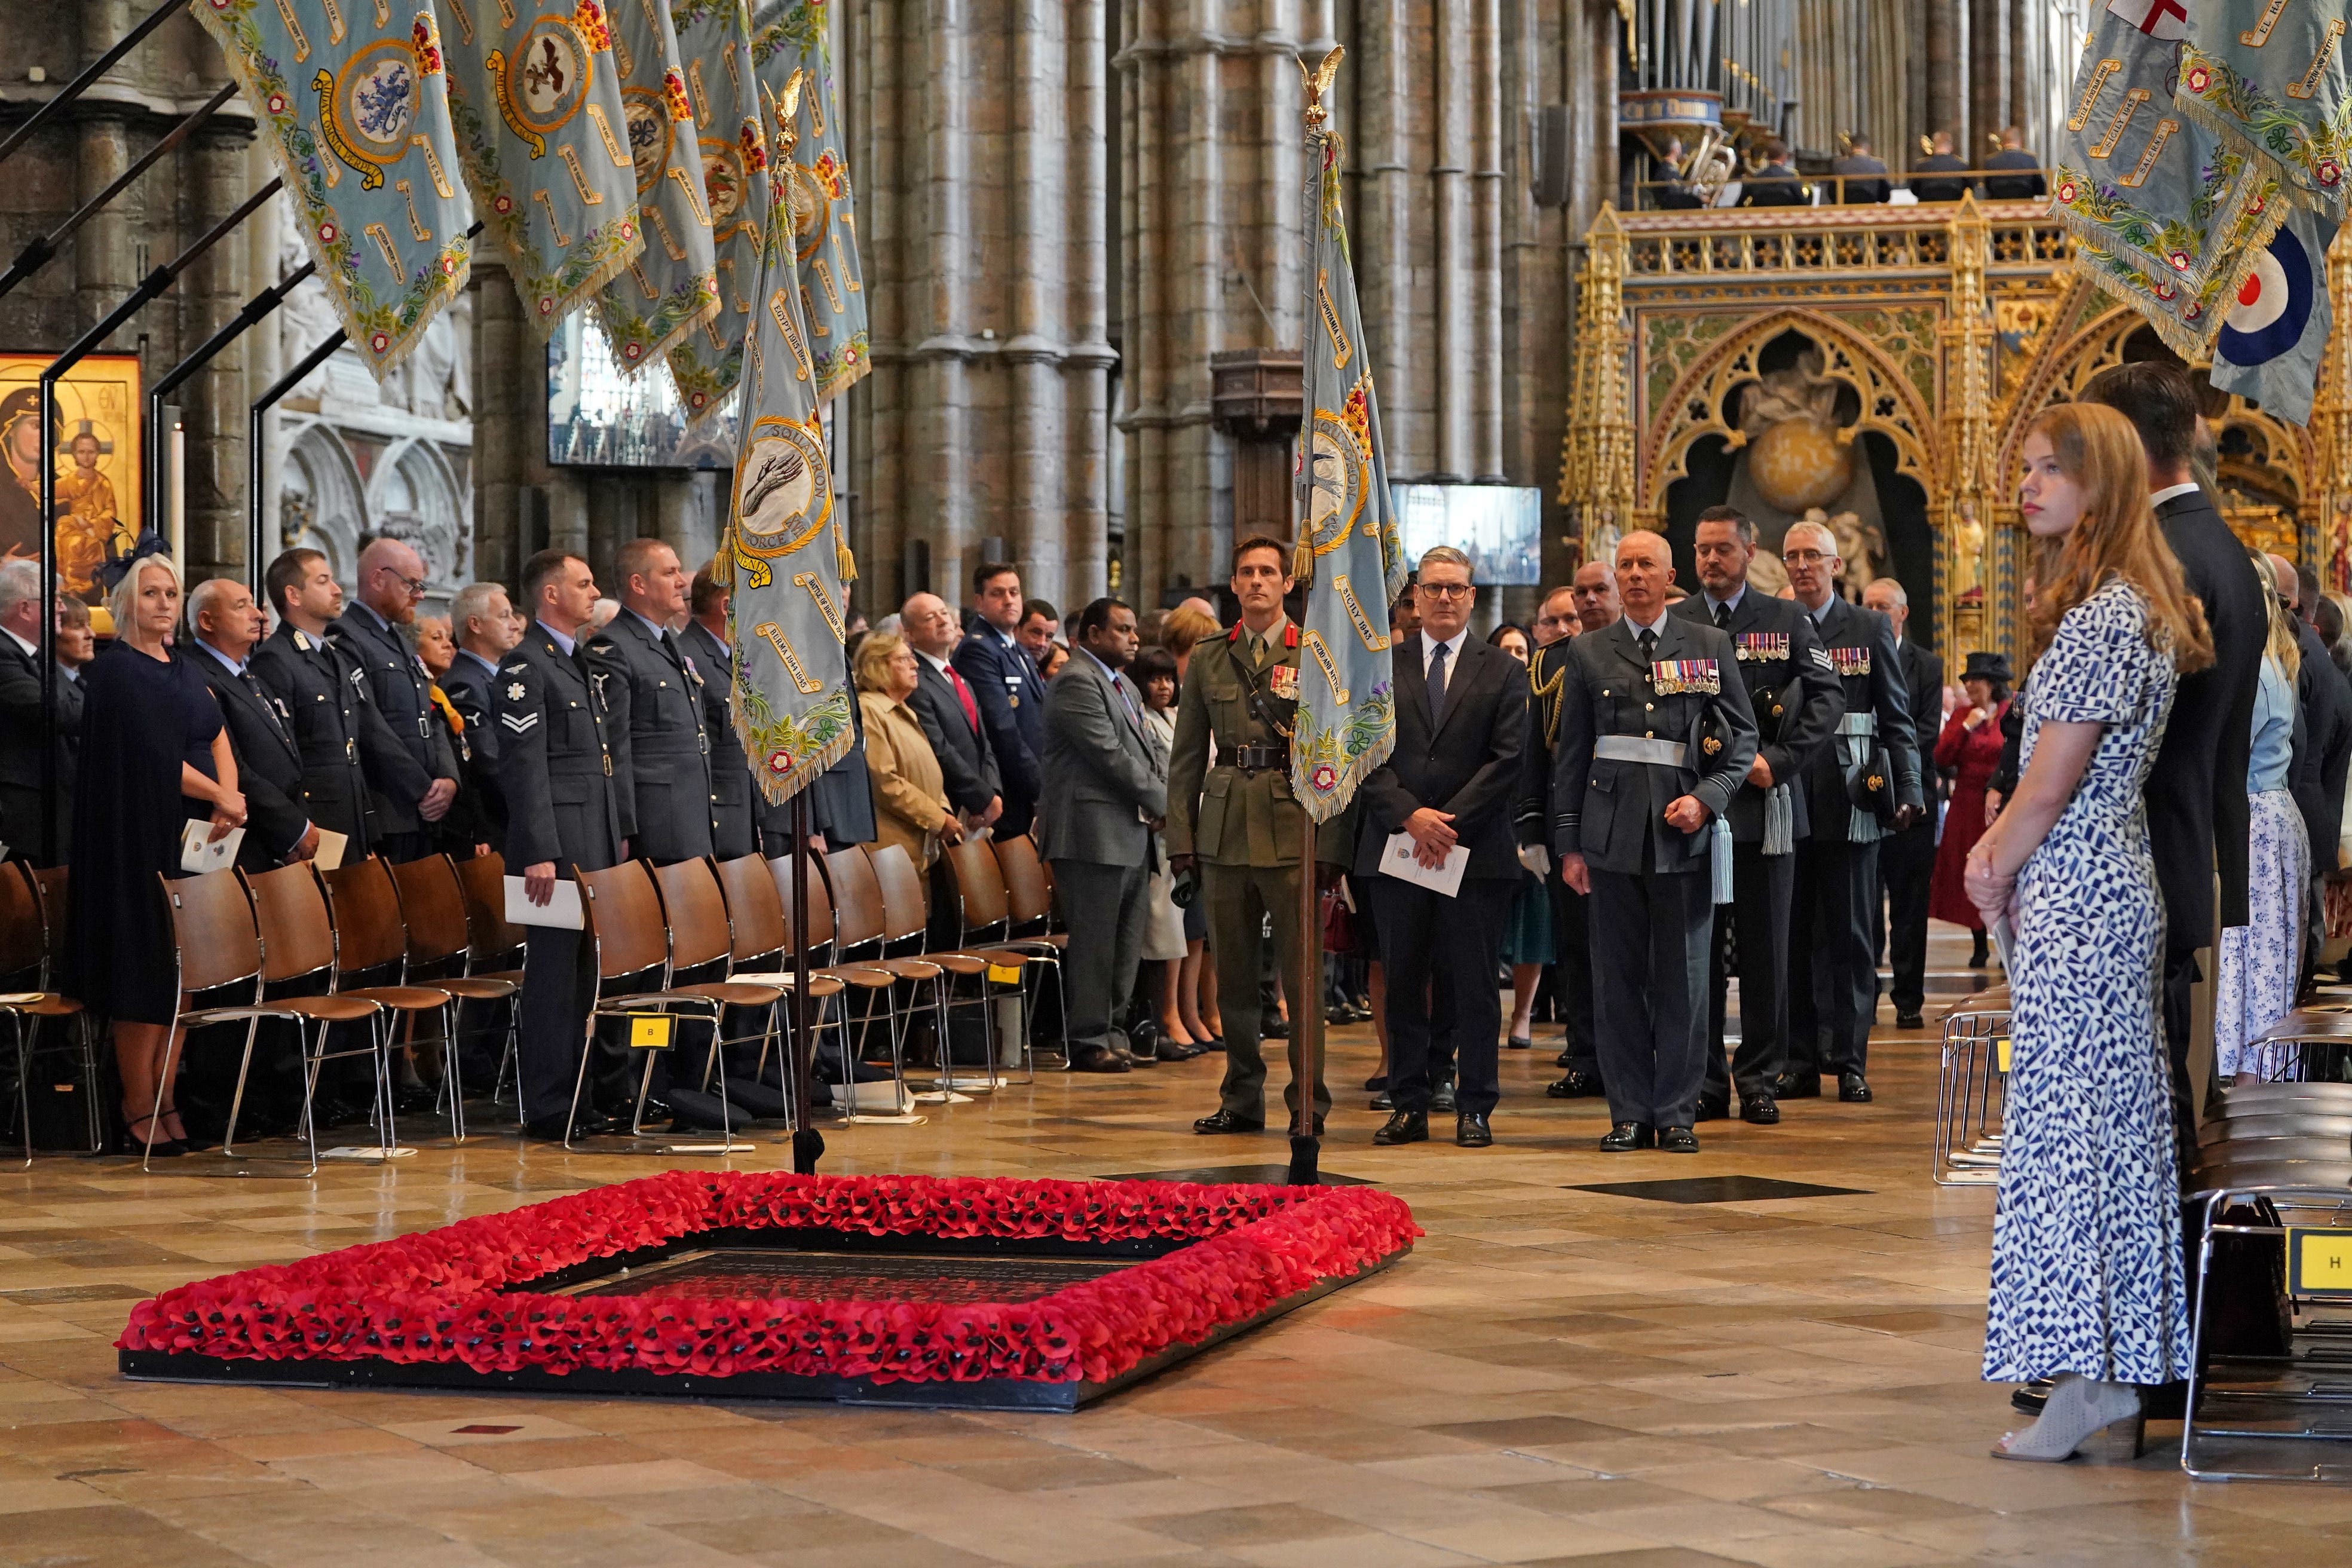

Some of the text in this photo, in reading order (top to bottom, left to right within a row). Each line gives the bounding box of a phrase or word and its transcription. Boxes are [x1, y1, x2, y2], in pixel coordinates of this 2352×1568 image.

[2259, 22, 2271, 33] EL
[2306, 70, 2319, 90] ANZIO
[2317, 57, 2326, 71] AND
[2077, 105, 2088, 125] BATTLE
[2088, 79, 2100, 100] BRITAIN
[2098, 66, 2108, 79] 1940
[597, 116, 611, 140] SOMME
[2105, 98, 2135, 148] SICILY 1943
[322, 149, 334, 169] 1991
[323, 120, 341, 153] OMNIA
[342, 152, 381, 178] PERPETI
[2139, 134, 2164, 174] SALERNO
[774, 305, 792, 332] EGYPT
[1319, 287, 1347, 352] MESOPOTAMIA 1918
[771, 425, 825, 498] SQUADRON
[745, 534, 787, 548] FORCE
[786, 516, 808, 538] XVII
[1325, 517, 1340, 536] 72
[808, 579, 845, 639] BATTLE OF BRITAIN 1940
[1343, 587, 1373, 641] SICILY 1943
[770, 629, 807, 688] BURMA 1944 1945
[1313, 641, 1325, 658] ANZIO
[1322, 658, 1332, 670] AND
[2330, 1257, 2341, 1269] H
